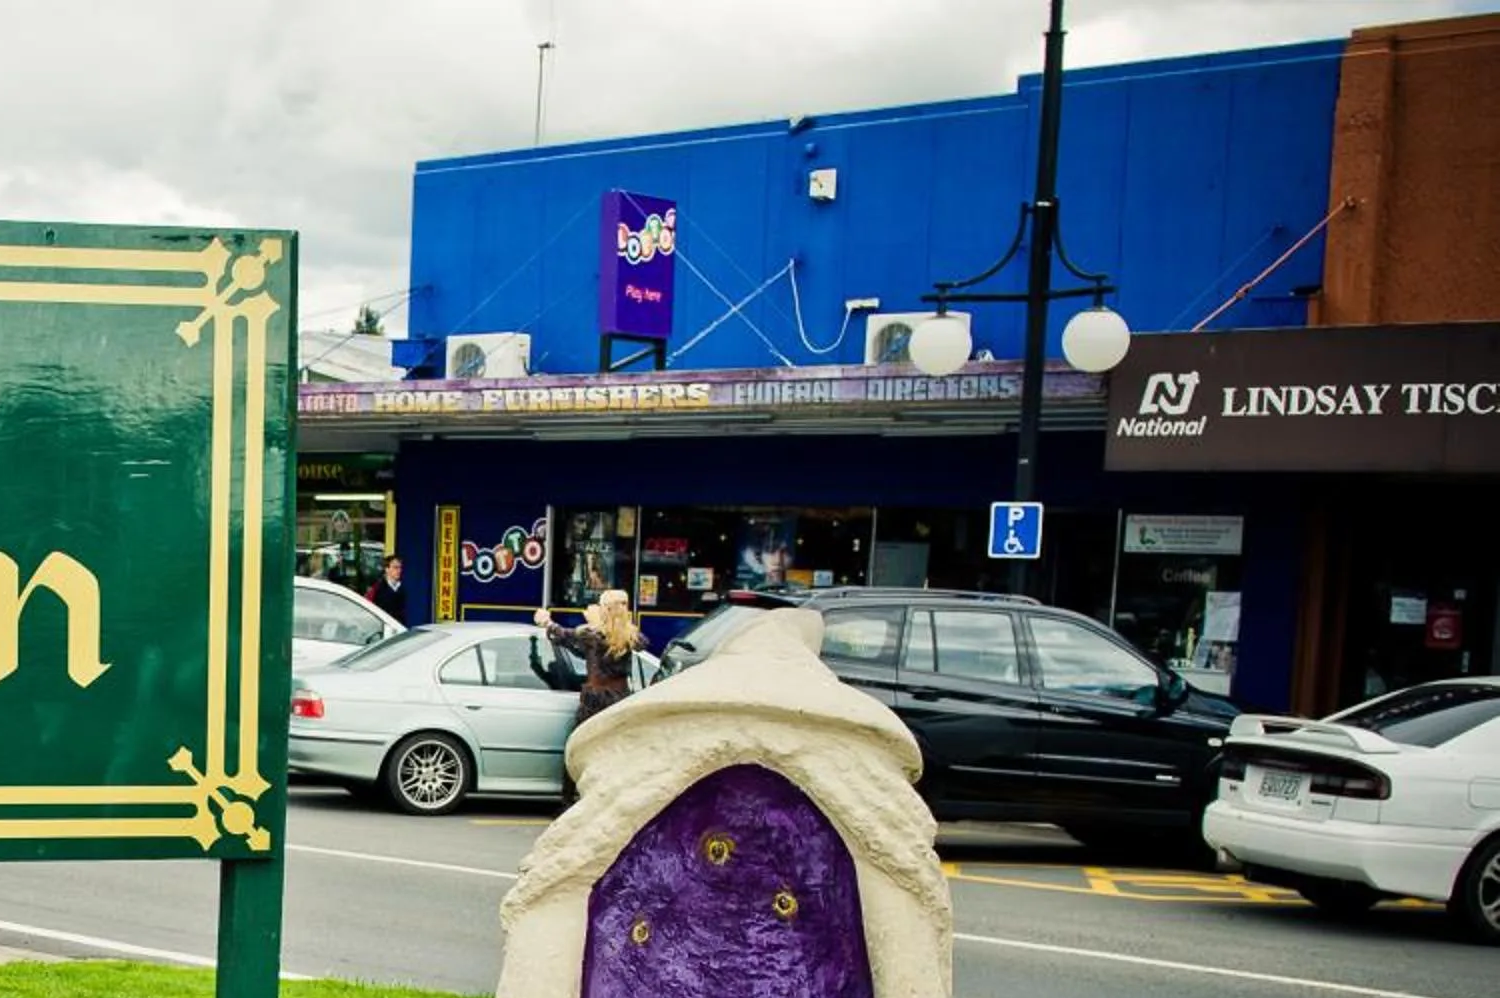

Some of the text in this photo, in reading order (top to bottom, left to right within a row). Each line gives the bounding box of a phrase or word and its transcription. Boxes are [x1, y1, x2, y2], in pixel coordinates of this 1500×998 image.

[376, 391, 464, 412] HOME
[482, 383, 712, 412] FURNISHERS
[735, 383, 838, 405] FUNERAL
[868, 375, 1018, 400] DIRECTORS
[1221, 383, 1500, 417] LINDSAY TISC
[1117, 416, 1207, 437] National
[1008, 508, 1025, 527] P
[441, 511, 454, 613] RETURNS
